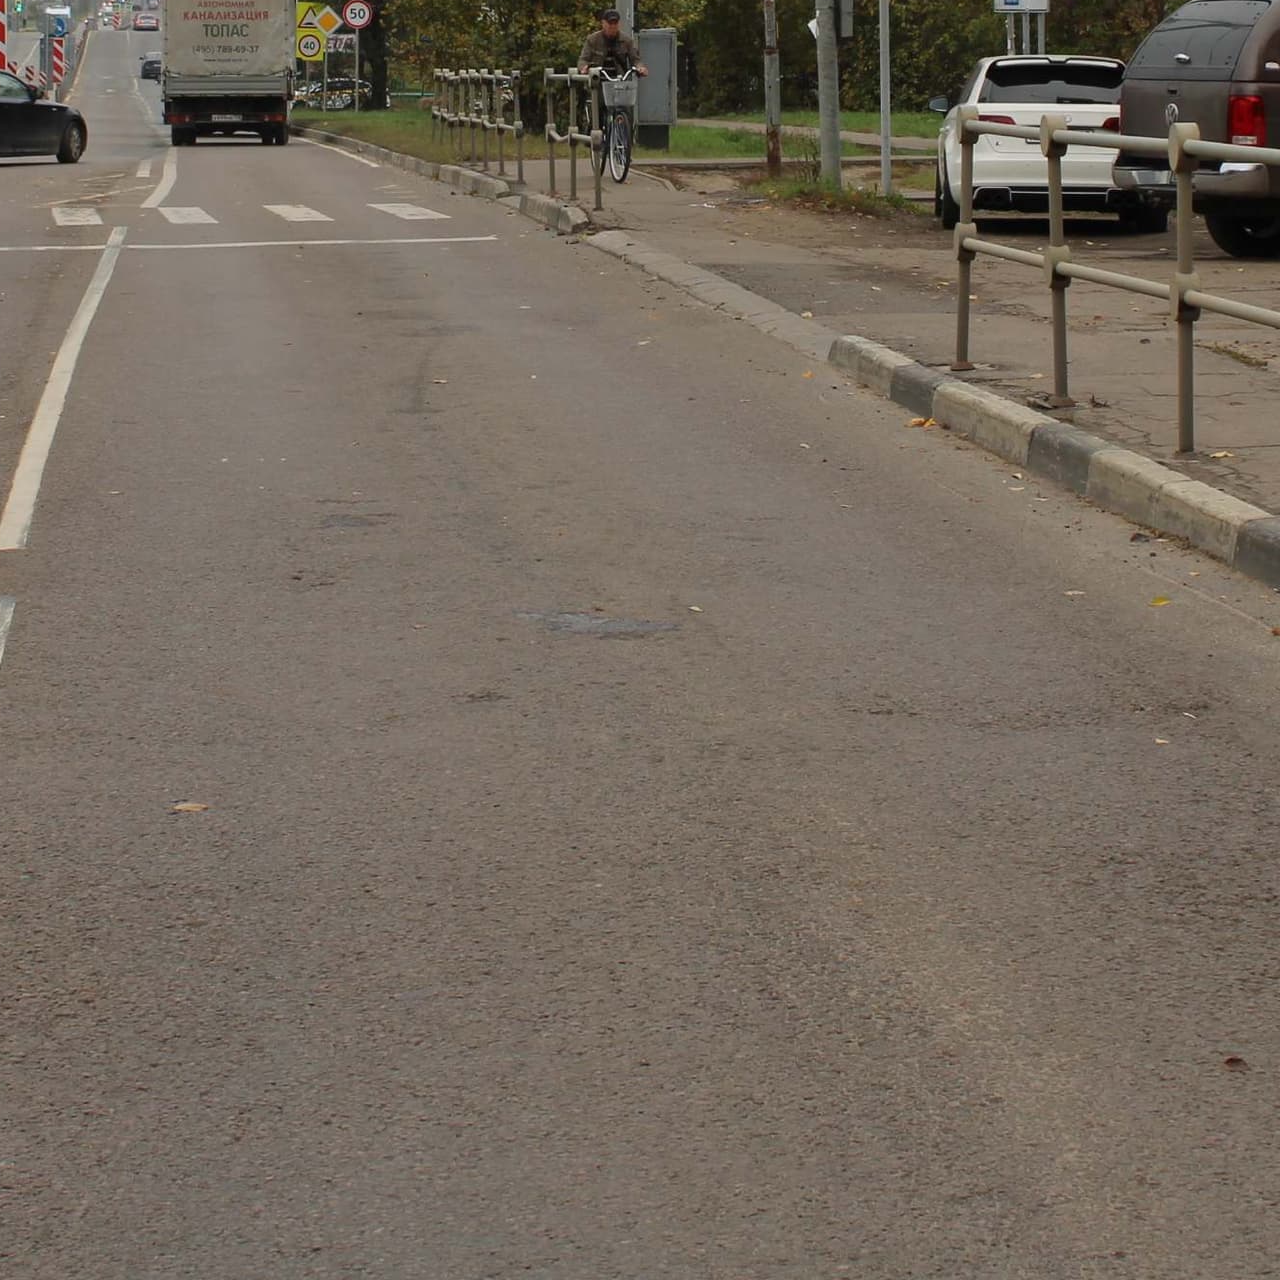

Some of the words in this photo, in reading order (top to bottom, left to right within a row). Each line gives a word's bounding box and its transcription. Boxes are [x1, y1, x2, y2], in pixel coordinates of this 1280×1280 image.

[197, 1, 255, 9] АВТОНОМНАЯ
[183, 11, 269, 21] КАНАЛИЗАЦИЯ
[350, 8, 365, 19] 50
[202, 24, 249, 37] ТОПАС
[303, 41, 315, 50] 40
